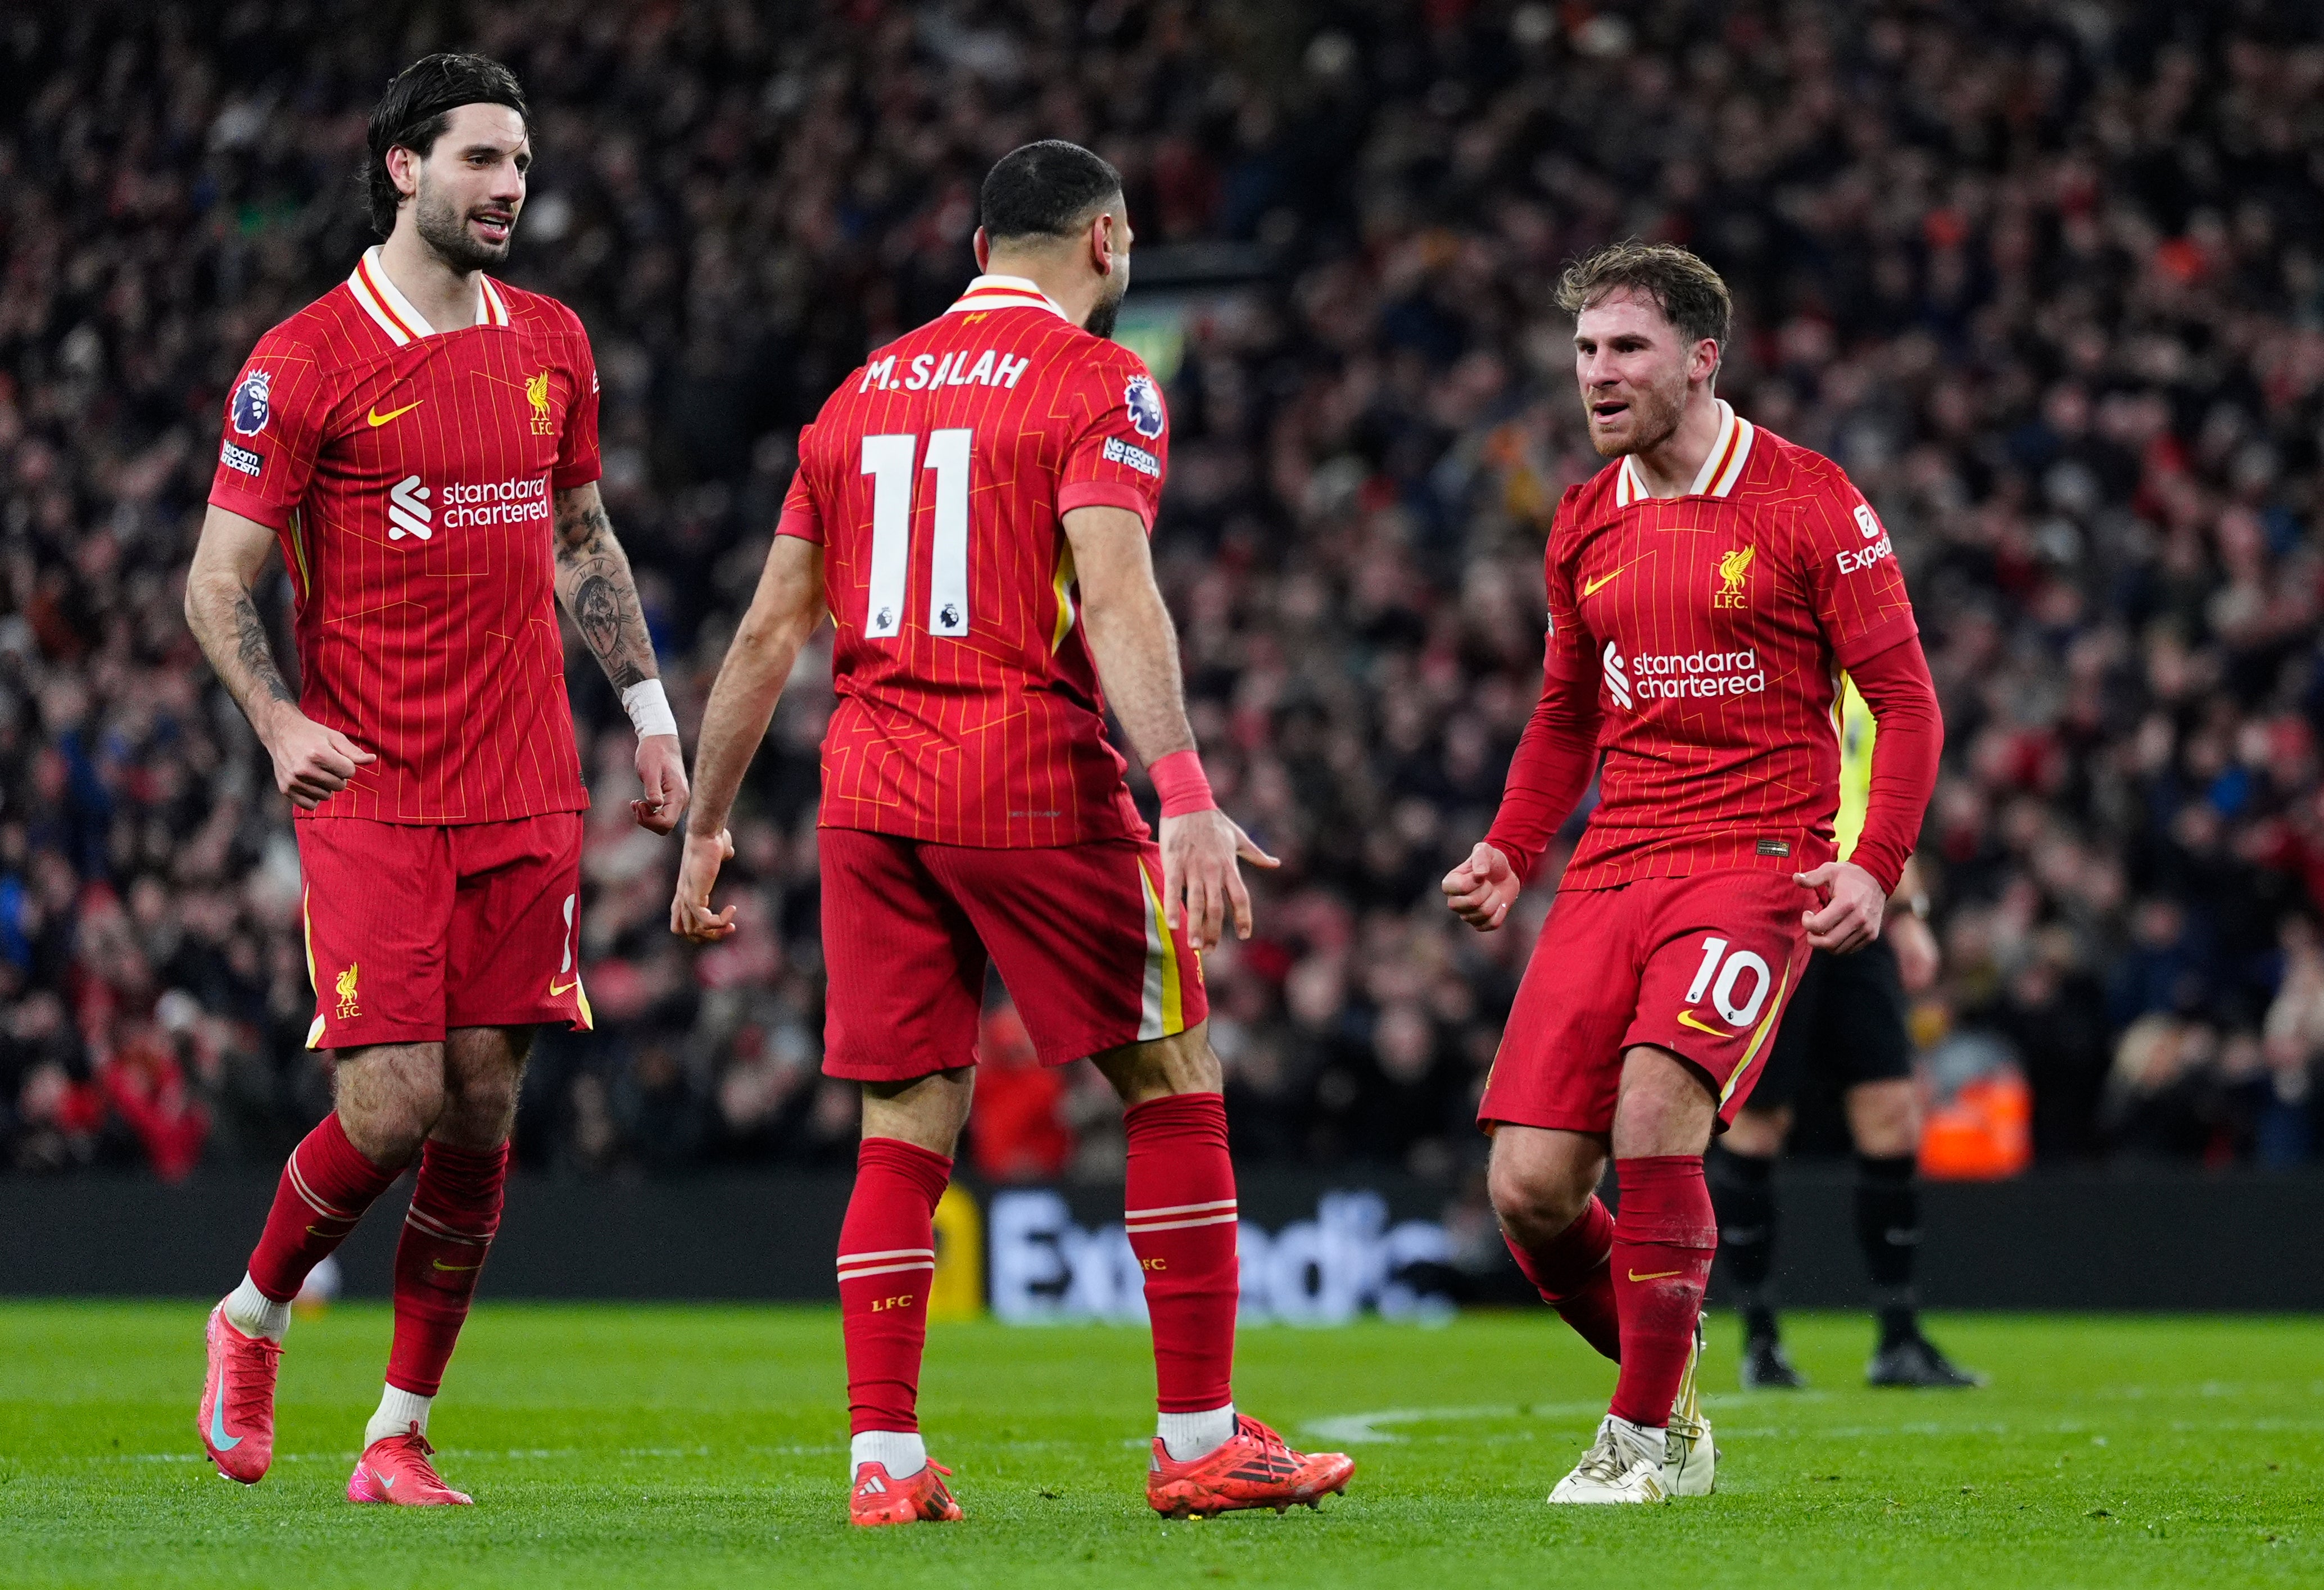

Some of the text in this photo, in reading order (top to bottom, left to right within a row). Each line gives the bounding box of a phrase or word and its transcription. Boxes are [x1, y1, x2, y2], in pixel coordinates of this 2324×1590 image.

[1102, 450, 1160, 479] for racism
[1106, 437, 1156, 467] No room
[443, 474, 548, 505] standard
[444, 495, 549, 528] chartered
[861, 428, 972, 639] 11
[1714, 594, 1748, 609] L.F.C.
[1633, 647, 1755, 676] standard
[1636, 669, 1765, 699] chartered
[1684, 937, 1770, 1027] 10
[1141, 1258, 1167, 1271] FC
[871, 1294, 913, 1312] LFC
